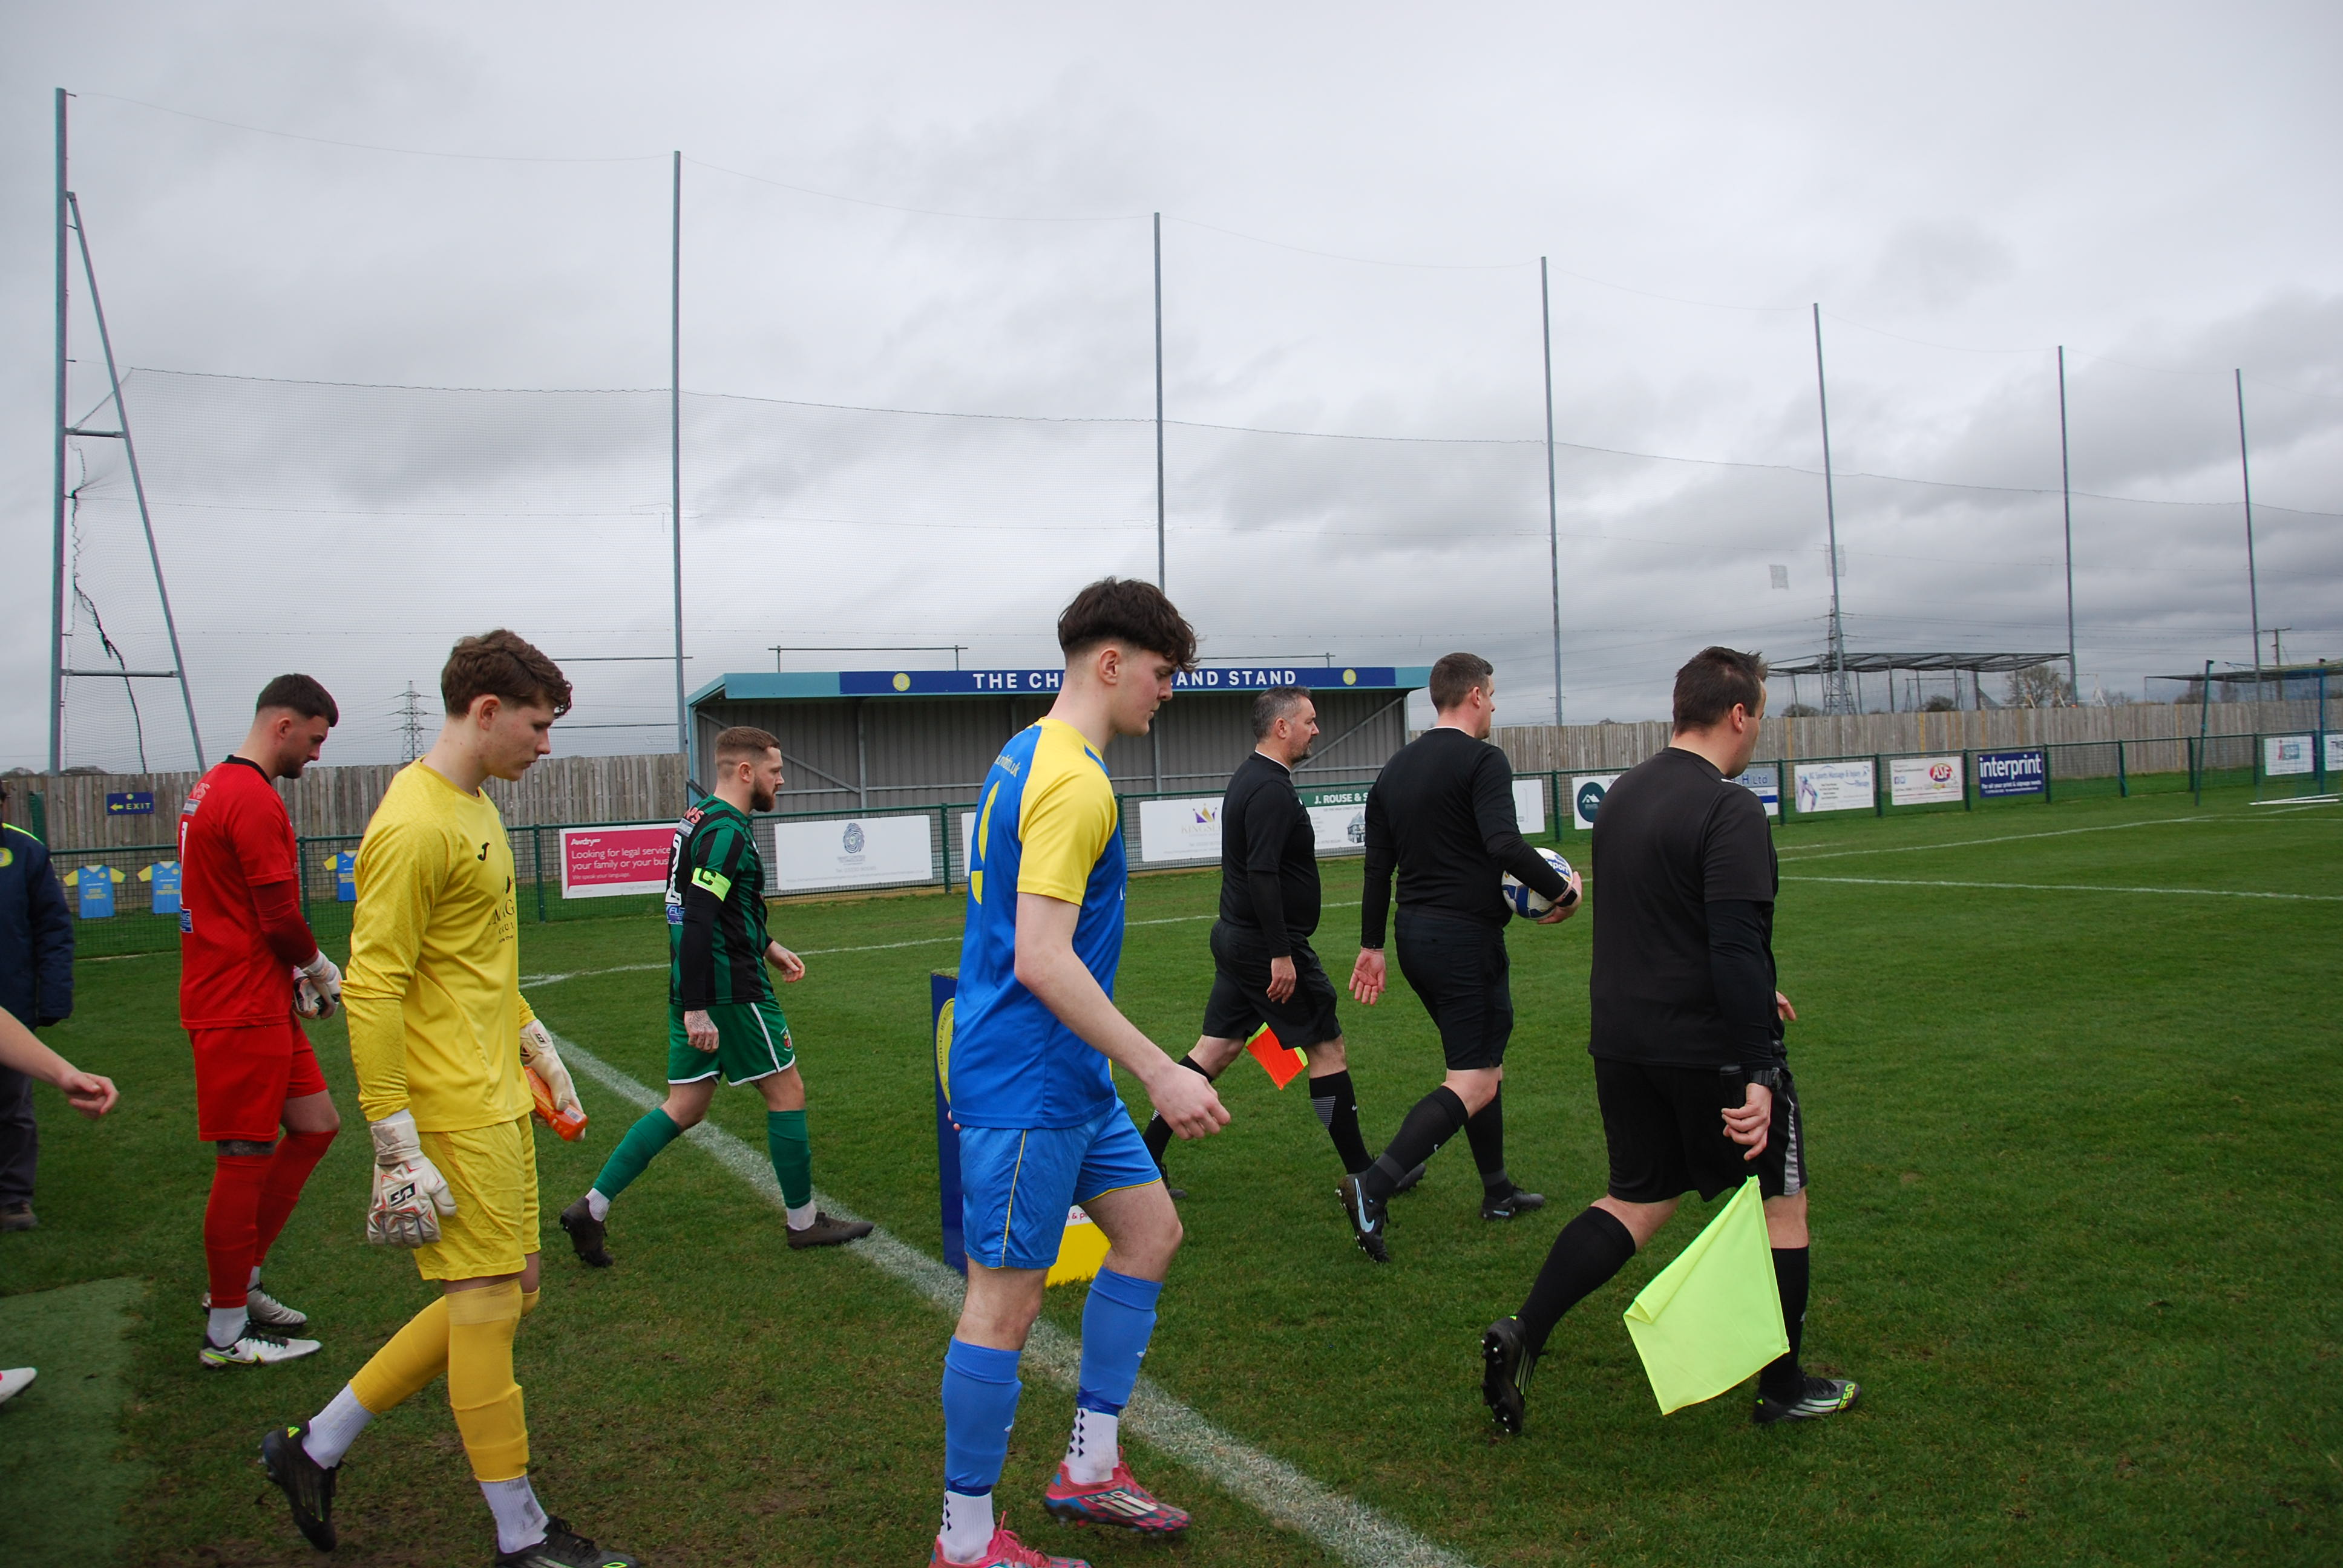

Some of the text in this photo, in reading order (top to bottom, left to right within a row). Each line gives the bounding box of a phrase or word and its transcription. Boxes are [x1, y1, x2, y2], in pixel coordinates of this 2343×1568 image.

[972, 672, 1065, 689] THE CH
[1170, 670, 1297, 687] AND STAND
[1932, 766, 1950, 779] ASF
[1979, 753, 2042, 780] interprint
[1752, 774, 1768, 785] Ltd
[1314, 792, 1369, 805] J. ROUSE & S
[571, 846, 671, 860] Looking for legal service
[572, 862, 592, 872] your
[594, 859, 618, 870] family
[632, 858, 652, 869] your
[654, 857, 670, 866] busi
